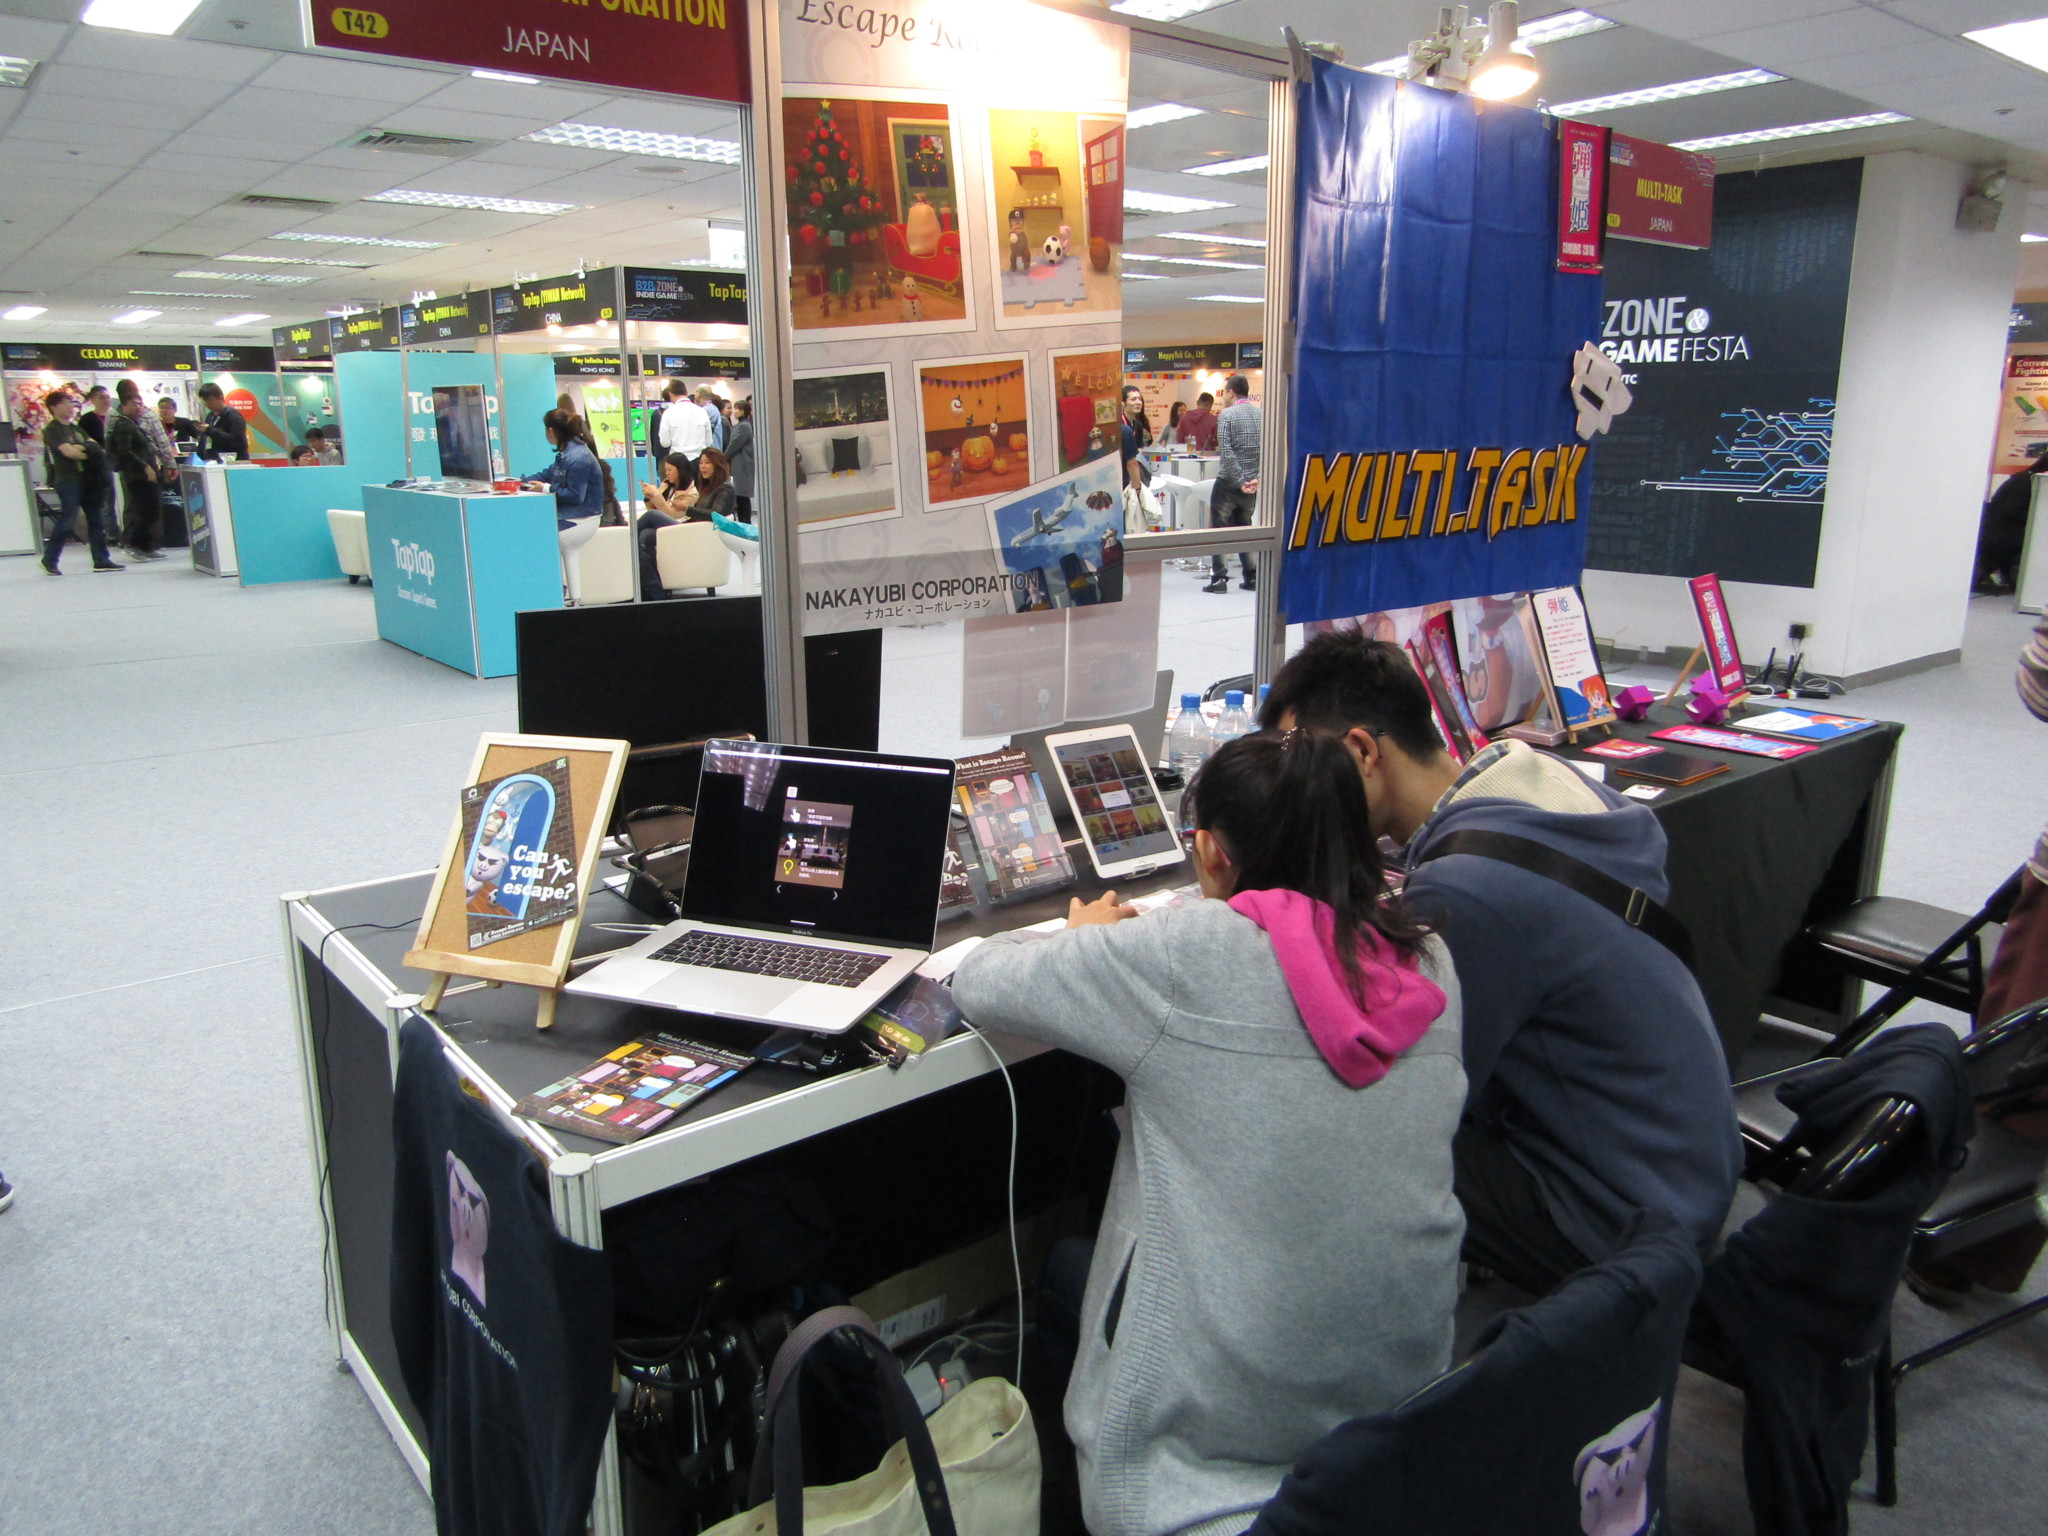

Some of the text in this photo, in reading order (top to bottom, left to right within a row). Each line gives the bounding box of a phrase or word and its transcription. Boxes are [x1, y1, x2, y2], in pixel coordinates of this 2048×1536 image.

[342, 10, 377, 35] T42
[502, 26, 590, 63] JAPAN
[1636, 178, 1683, 206] MULTI-TASK
[1649, 217, 1673, 232] JAPAN
[636, 291, 655, 299] INDIE
[656, 292, 677, 300] GAME
[657, 281, 678, 293] ZONE
[522, 293, 540, 309] TapTap
[546, 313, 562, 324] CHINA
[1602, 296, 1686, 338] ZONE
[81, 349, 139, 360] CELAD INC.
[1681, 336, 1750, 362] FESTA
[572, 357, 583, 365] Play
[709, 360, 745, 369] Google Cloud
[391, 538, 435, 585] TapTap
[805, 572, 1039, 610] NAKAYUBI CORPORATION
[864, 598, 991, 620] ナカユビ・コーポレーション
[979, 757, 1002, 766] Escape
[1001, 752, 1026, 762] Rooms?
[513, 844, 548, 864] Can
[509, 864, 545, 881] you
[503, 881, 576, 902] escape?
[658, 1032, 682, 1043] What
[689, 1041, 719, 1053] Escape
[719, 1049, 755, 1061] Rooms?
